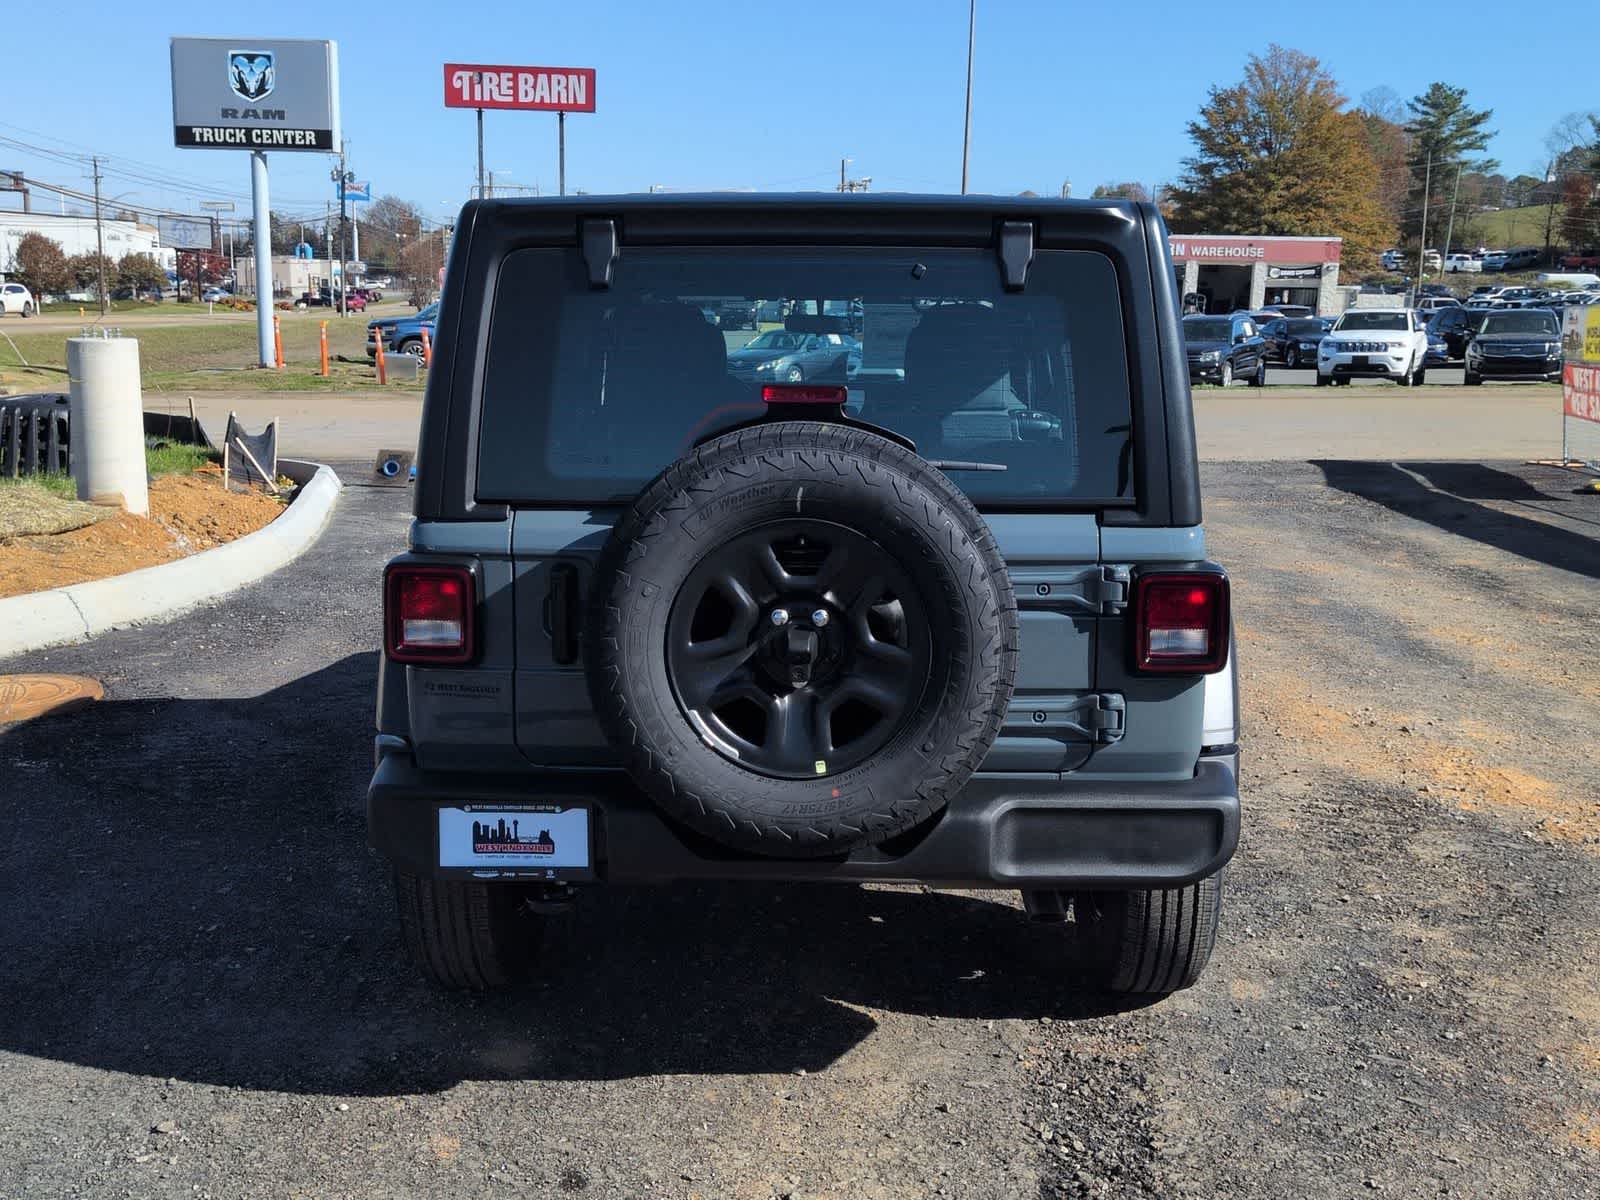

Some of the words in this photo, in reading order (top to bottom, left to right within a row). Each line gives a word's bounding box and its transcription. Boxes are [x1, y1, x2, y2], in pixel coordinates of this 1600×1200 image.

[518, 72, 586, 104] BARN
[221, 108, 285, 120] RAM
[192, 127, 246, 143] TRUCK
[252, 129, 316, 145] CENTER
[1191, 247, 1265, 258] WAREHOUSE
